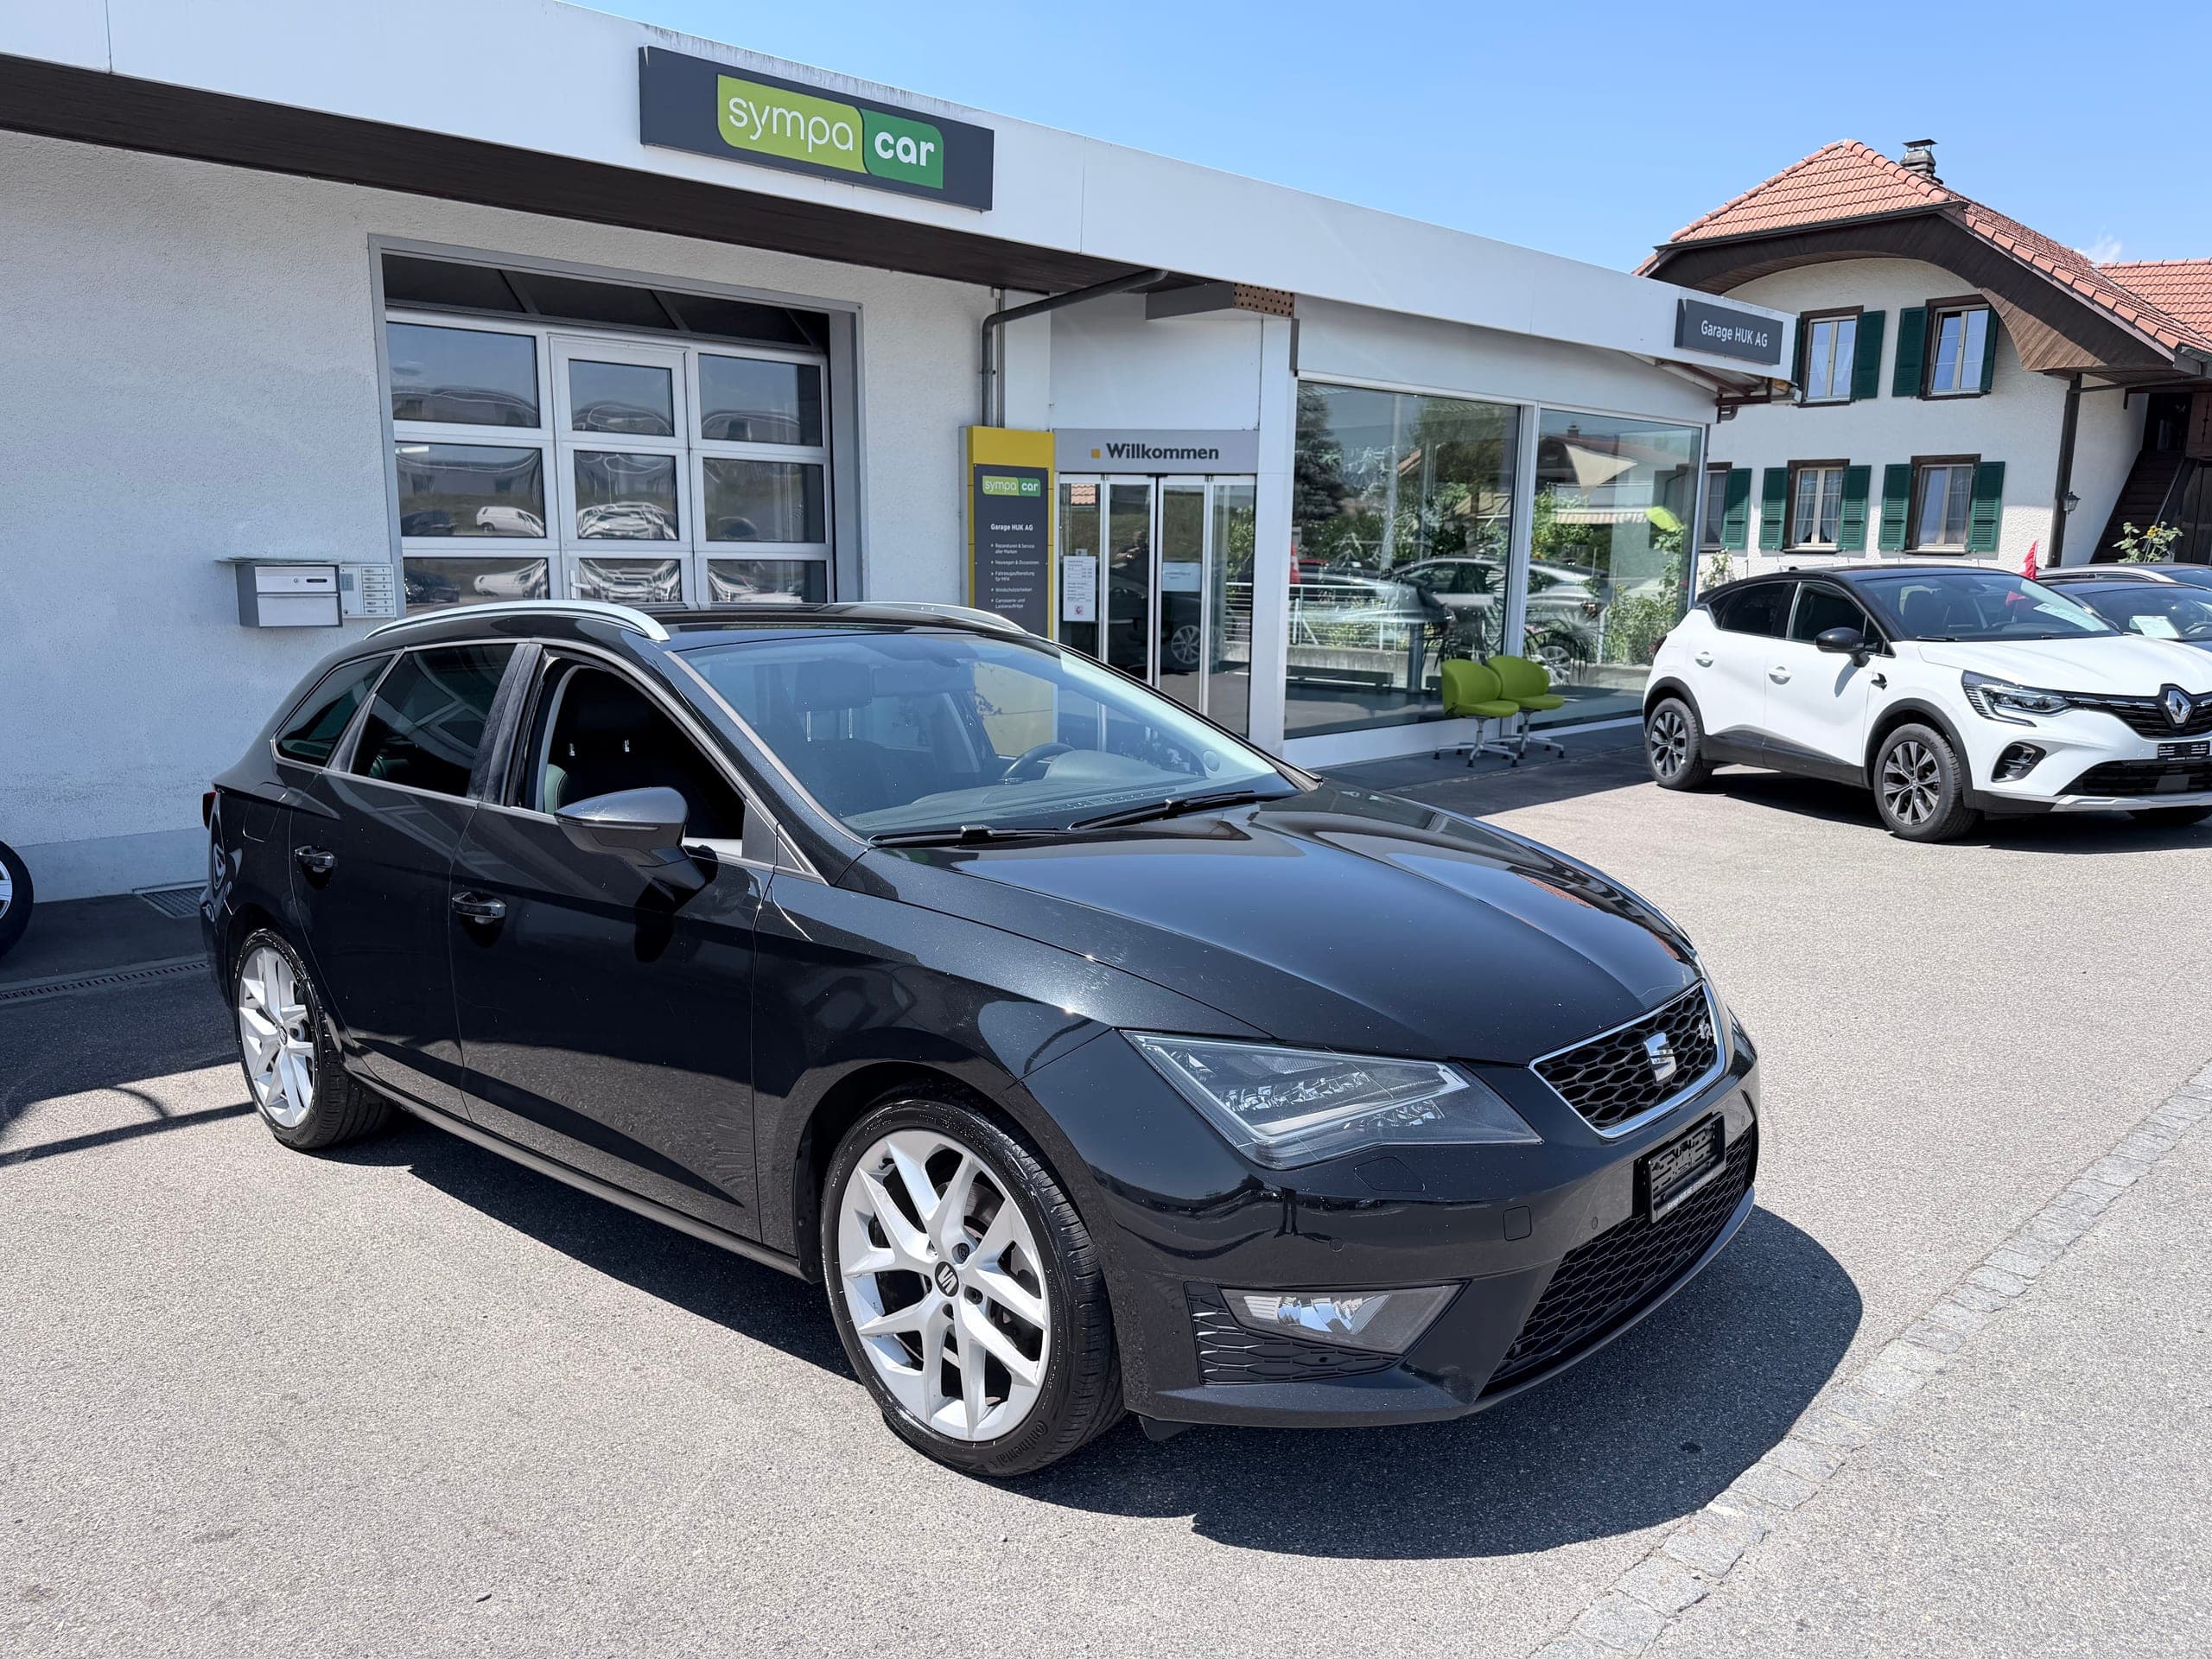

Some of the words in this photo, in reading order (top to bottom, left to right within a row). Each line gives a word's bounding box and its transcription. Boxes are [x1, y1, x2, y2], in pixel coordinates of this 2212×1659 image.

[728, 97, 854, 153] sympa
[874, 131, 935, 167] car
[1700, 320, 1732, 342] Garage
[1734, 327, 1752, 345] HUK
[1754, 332, 1768, 347] AG
[1106, 442, 1219, 460] Willkommen
[984, 480, 1017, 492] sympa
[1021, 482, 1039, 492] car
[990, 523, 1011, 531] Garage
[996, 1420, 1049, 1466] Continental
